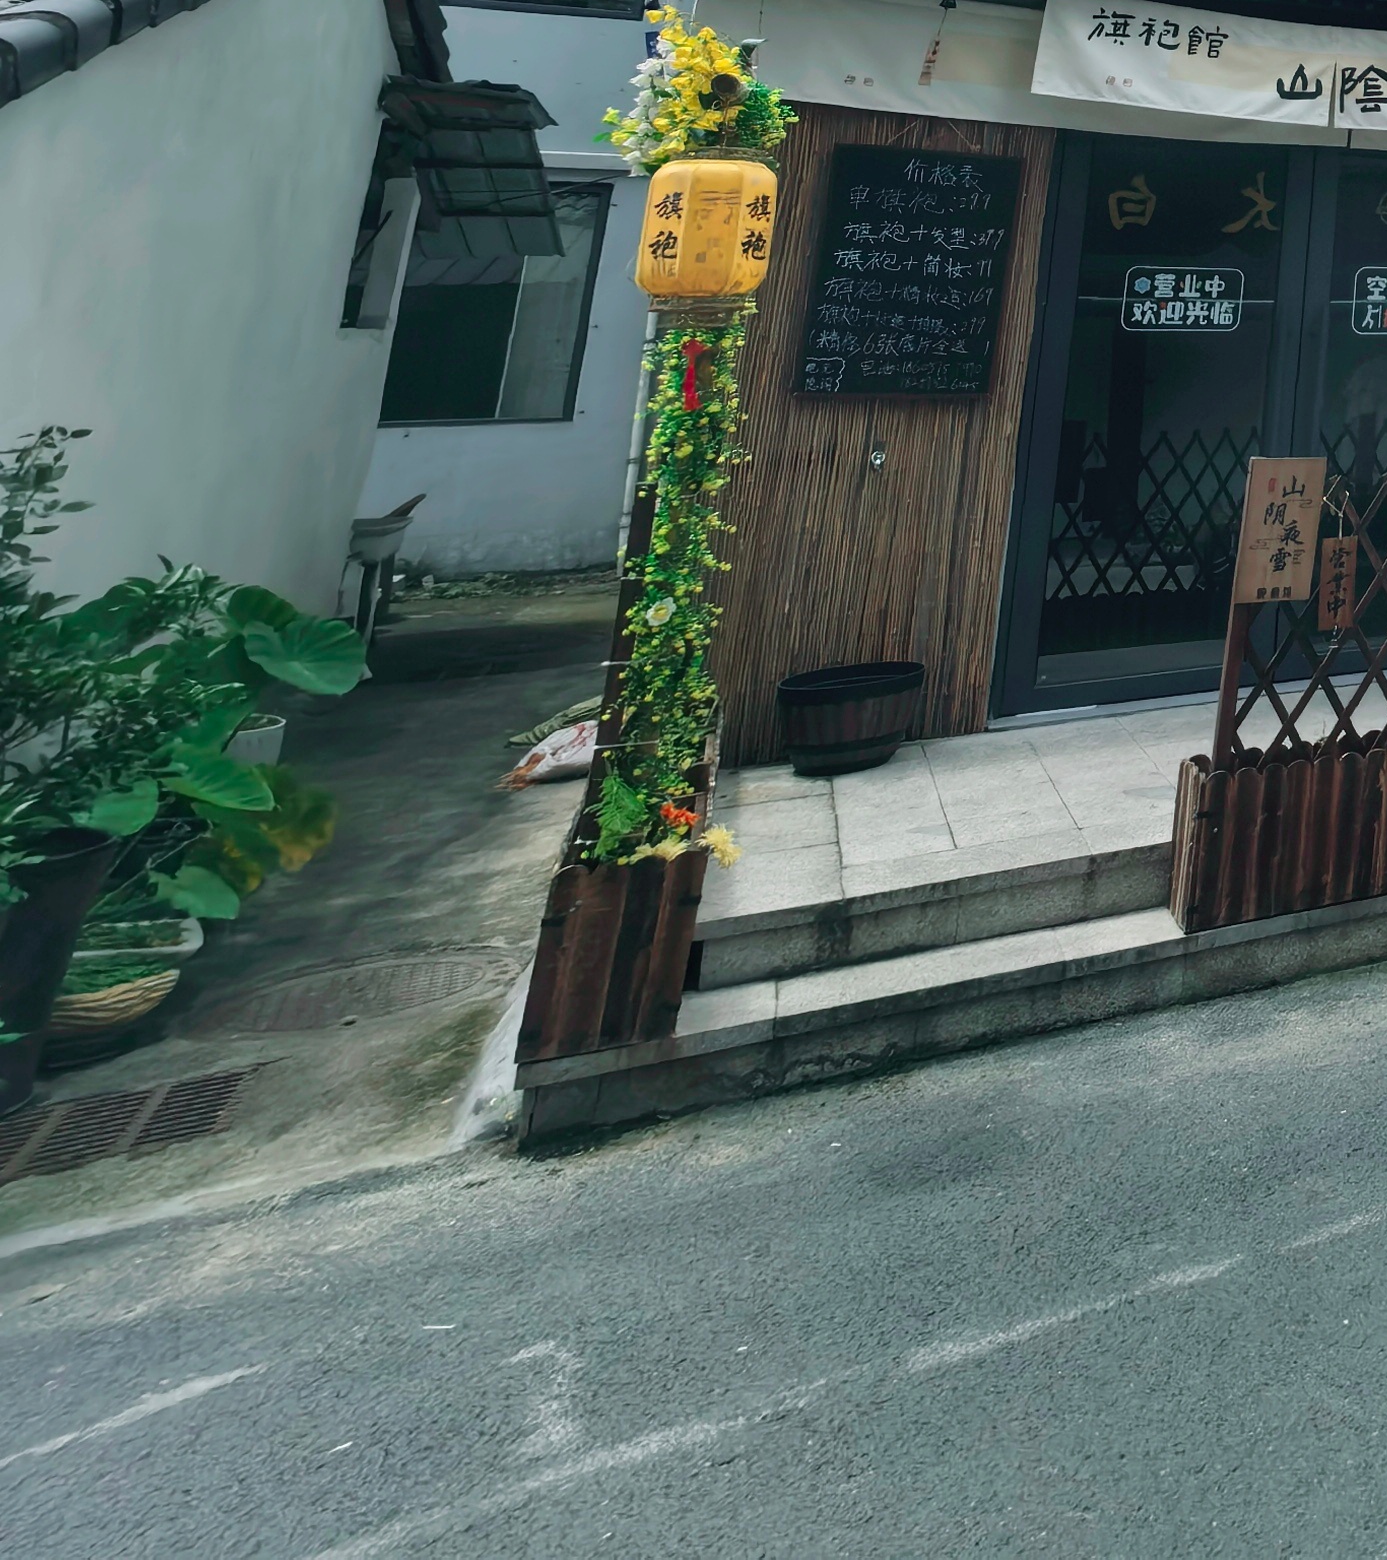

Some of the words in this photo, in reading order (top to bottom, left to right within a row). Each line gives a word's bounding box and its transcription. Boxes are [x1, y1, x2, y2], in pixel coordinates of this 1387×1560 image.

[904, 158, 983, 192] 价格表
[648, 191, 684, 261] 旗袍
[741, 193, 772, 262] 旗袍
[1154, 273, 1226, 299] 营业中
[1132, 300, 1235, 326] 欢迎光临
